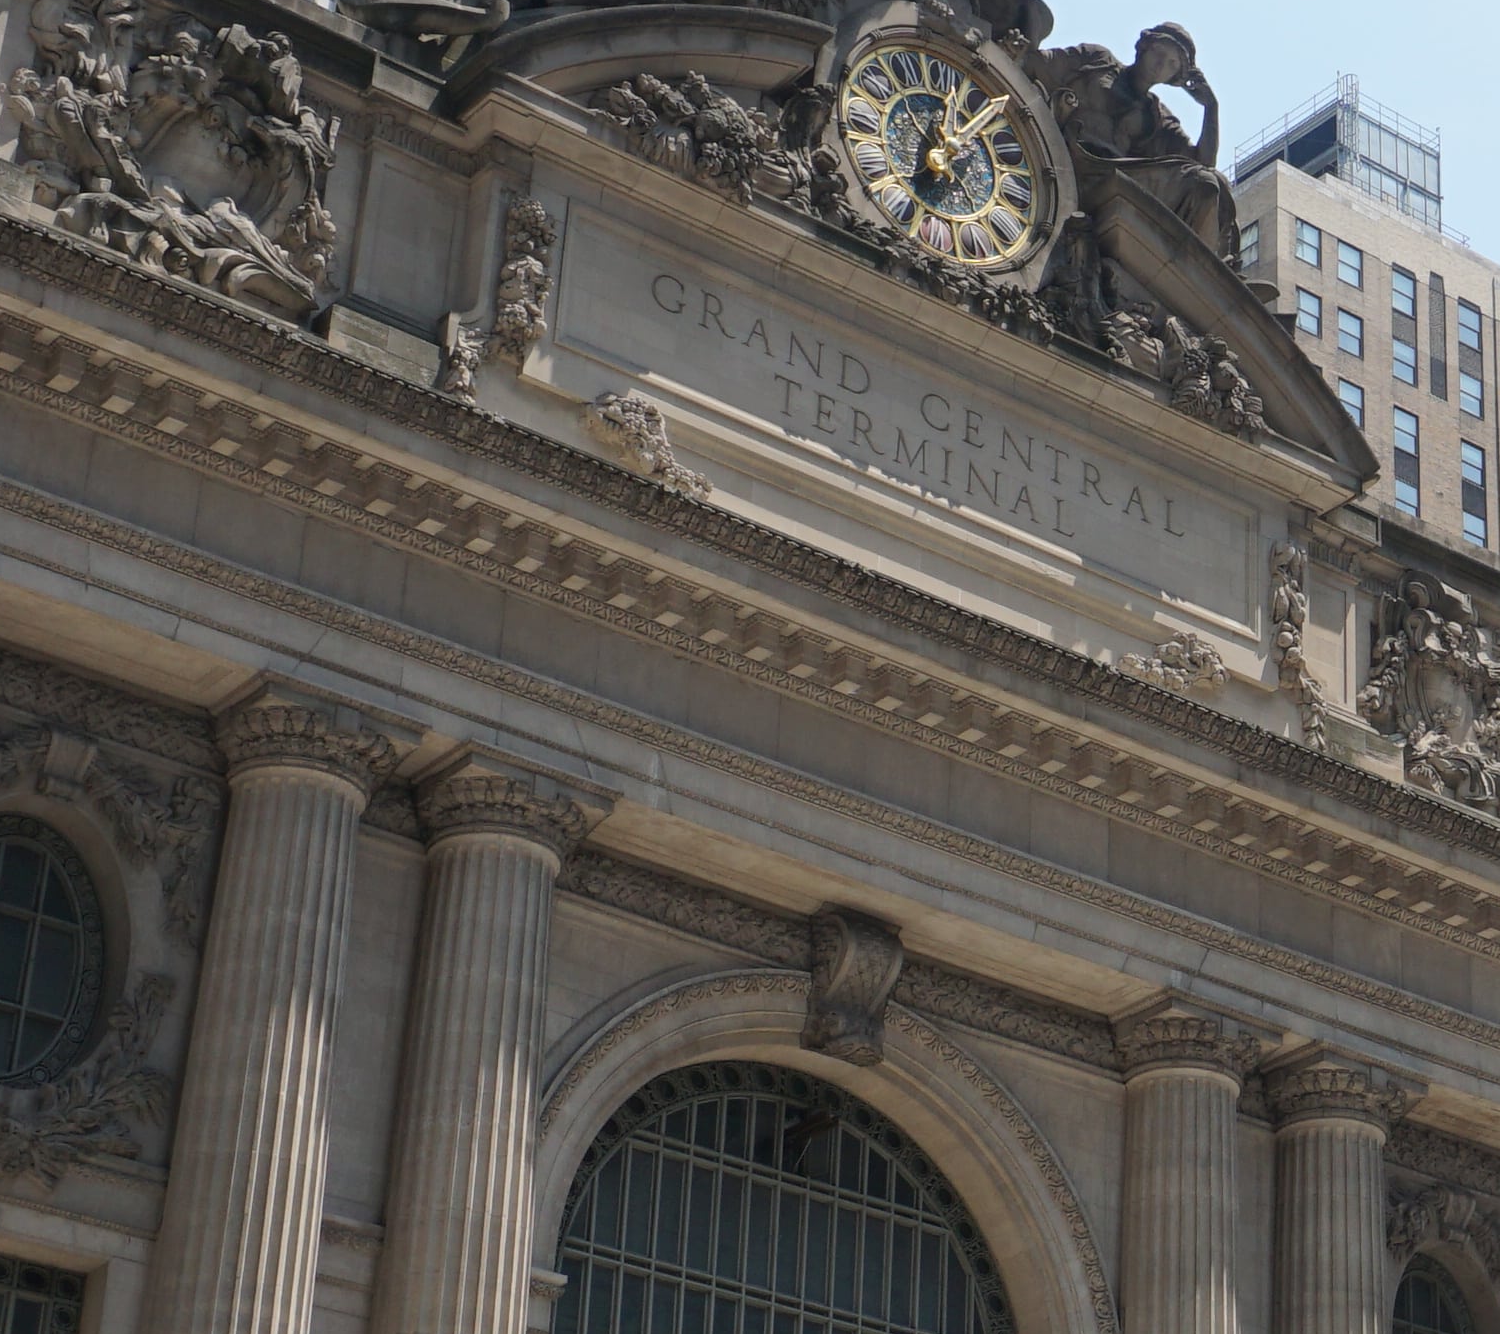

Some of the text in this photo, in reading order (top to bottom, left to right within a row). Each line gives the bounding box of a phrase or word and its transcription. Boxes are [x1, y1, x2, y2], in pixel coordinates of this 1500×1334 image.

[651, 273, 1185, 538] GRAND CENTRAL
[773, 373, 1076, 538] TERMINAL
